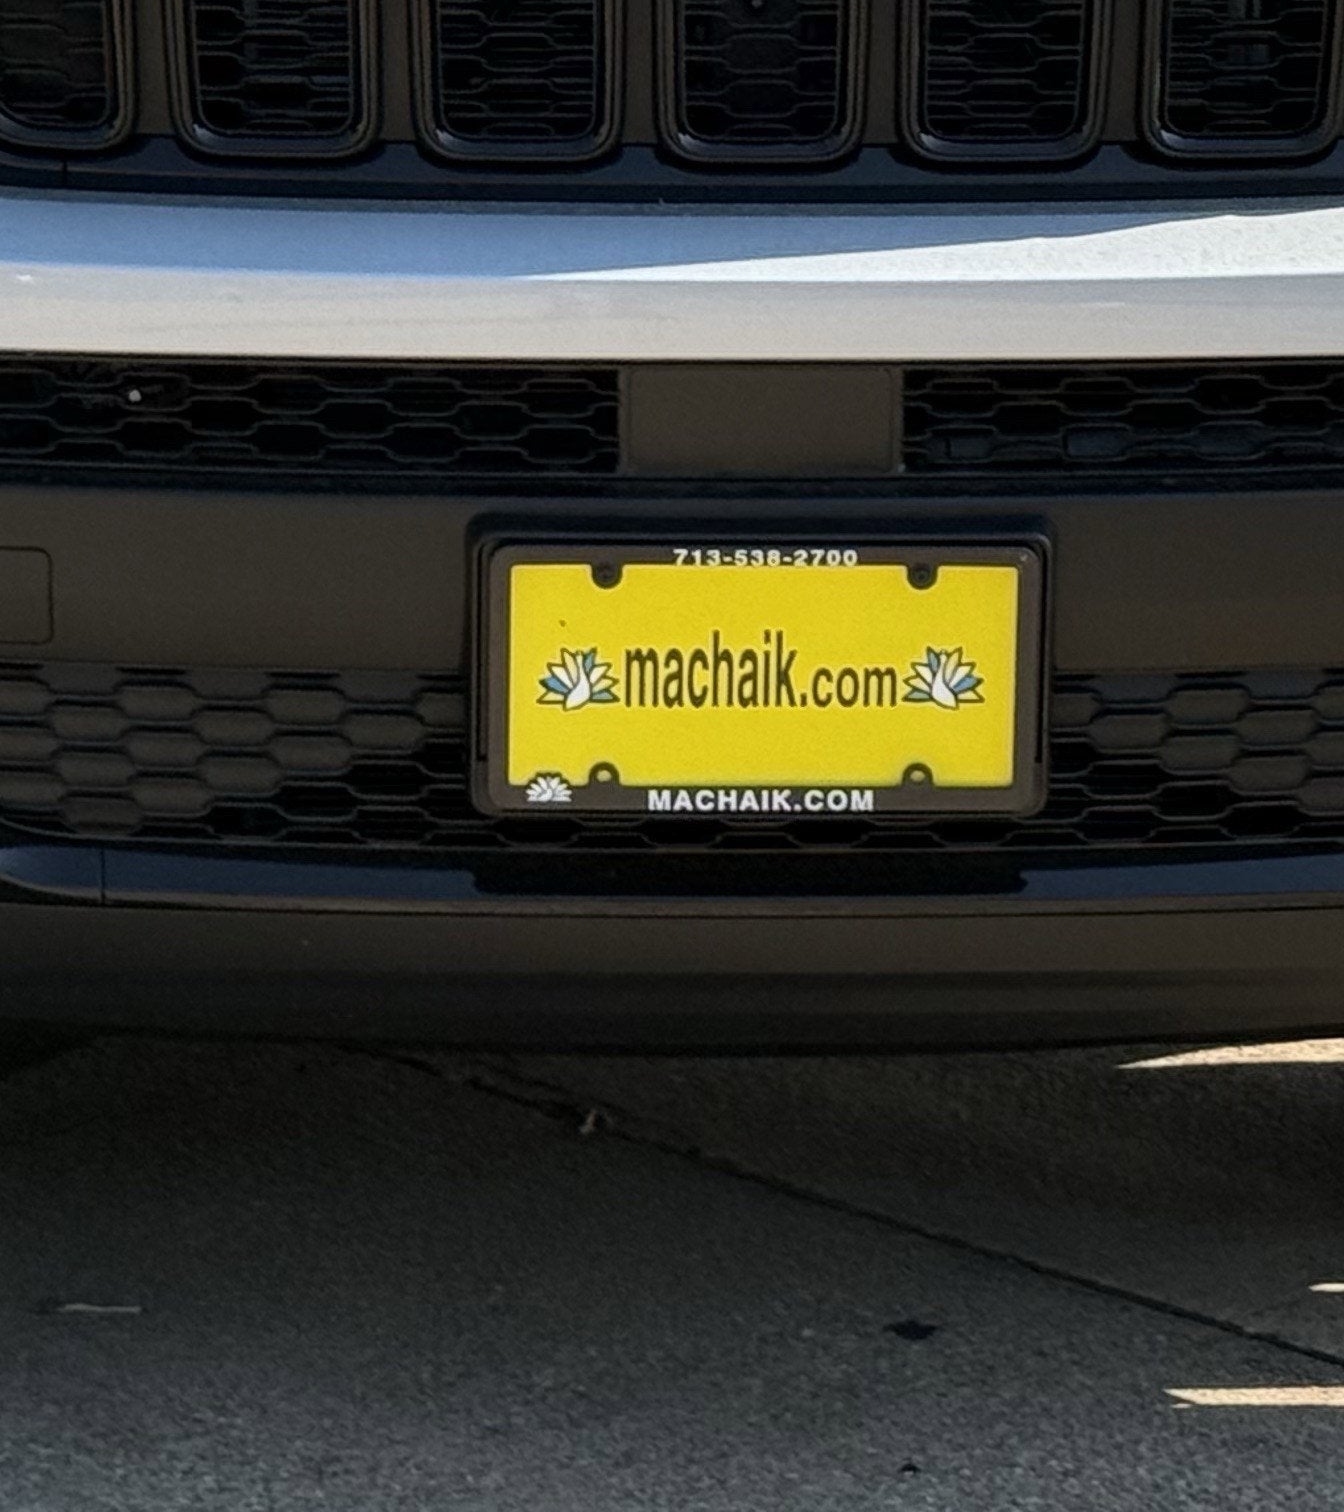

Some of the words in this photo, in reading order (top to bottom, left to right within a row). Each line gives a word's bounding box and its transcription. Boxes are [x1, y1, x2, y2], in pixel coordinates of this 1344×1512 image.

[671, 547, 861, 569] 713-538-2700
[624, 630, 899, 710] machaik.com
[646, 788, 877, 813] MACHAIK.COM
